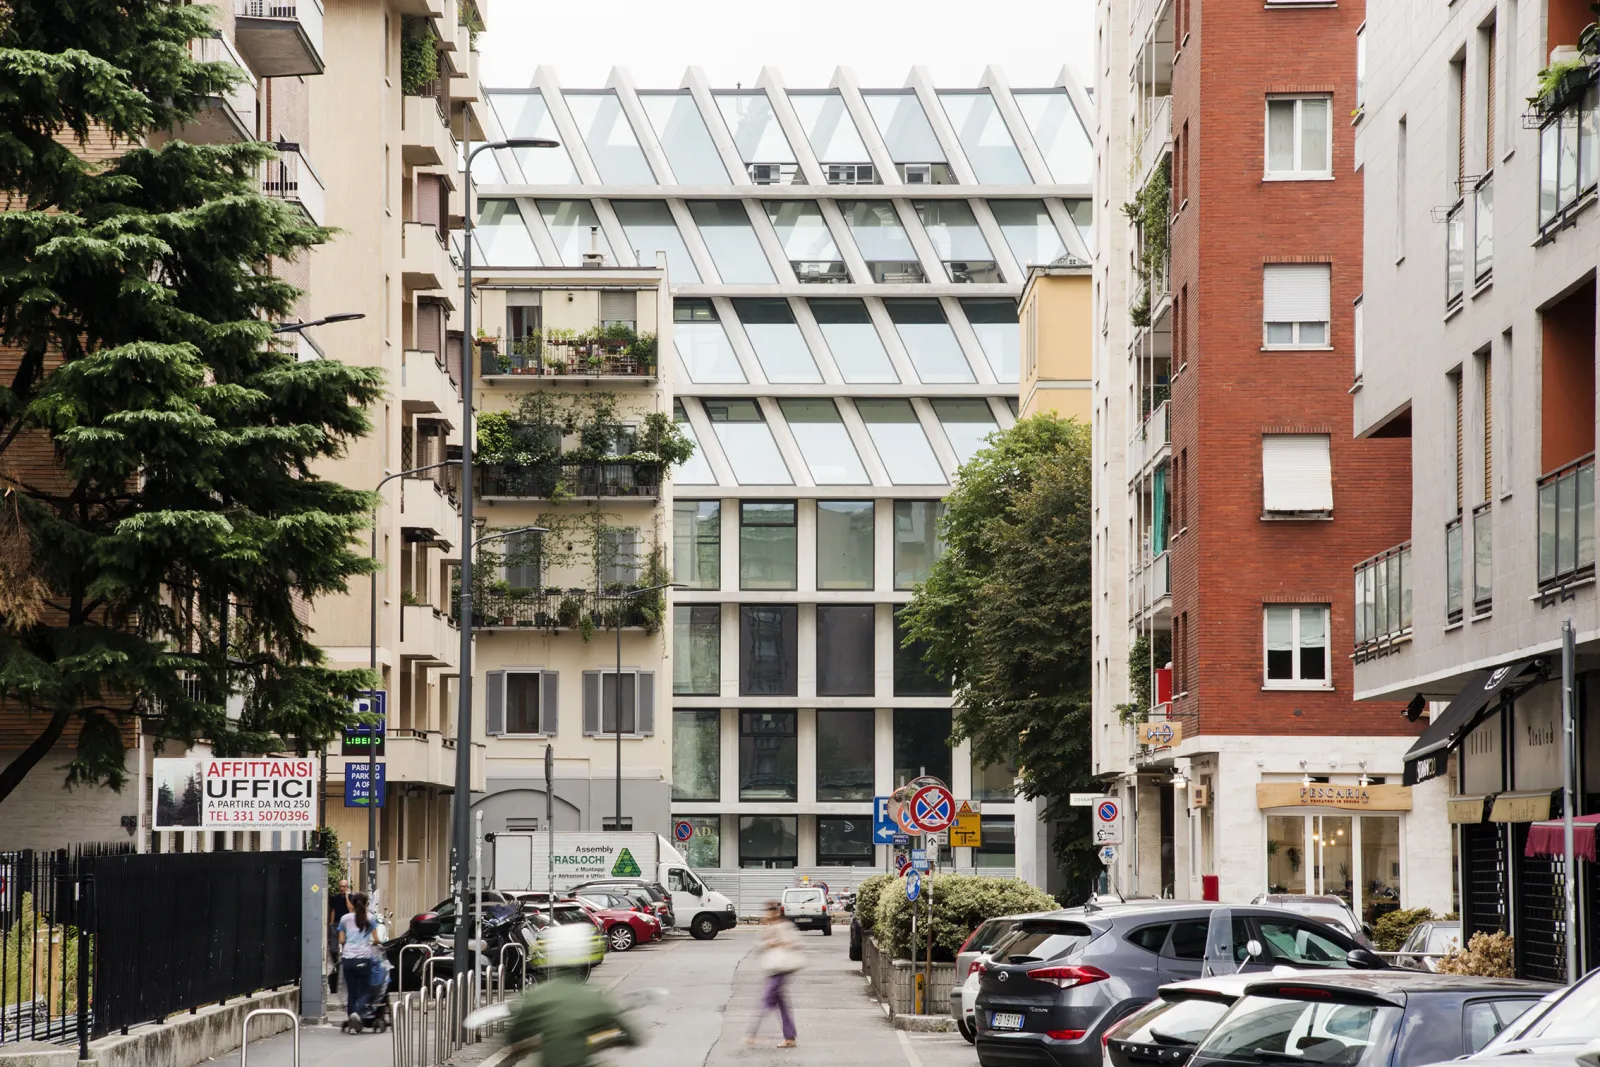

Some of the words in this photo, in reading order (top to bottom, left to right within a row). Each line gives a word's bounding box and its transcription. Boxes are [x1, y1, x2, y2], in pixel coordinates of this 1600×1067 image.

[345, 737, 381, 745] LIBEO
[207, 761, 313, 777] AFFITTANSI
[206, 779, 312, 798] UFFICI
[1300, 787, 1370, 799] PESCARIA
[208, 800, 215, 808] A
[217, 800, 255, 808] PARTIRE
[258, 800, 271, 808] DA
[274, 800, 291, 810] MQ
[293, 800, 310, 808] 250
[209, 811, 229, 821] TEL
[233, 811, 254, 821] 331
[258, 811, 309, 821] 5070396
[575, 845, 614, 854] Assembly
[1121, 1044, 1180, 1058] VOLVO
